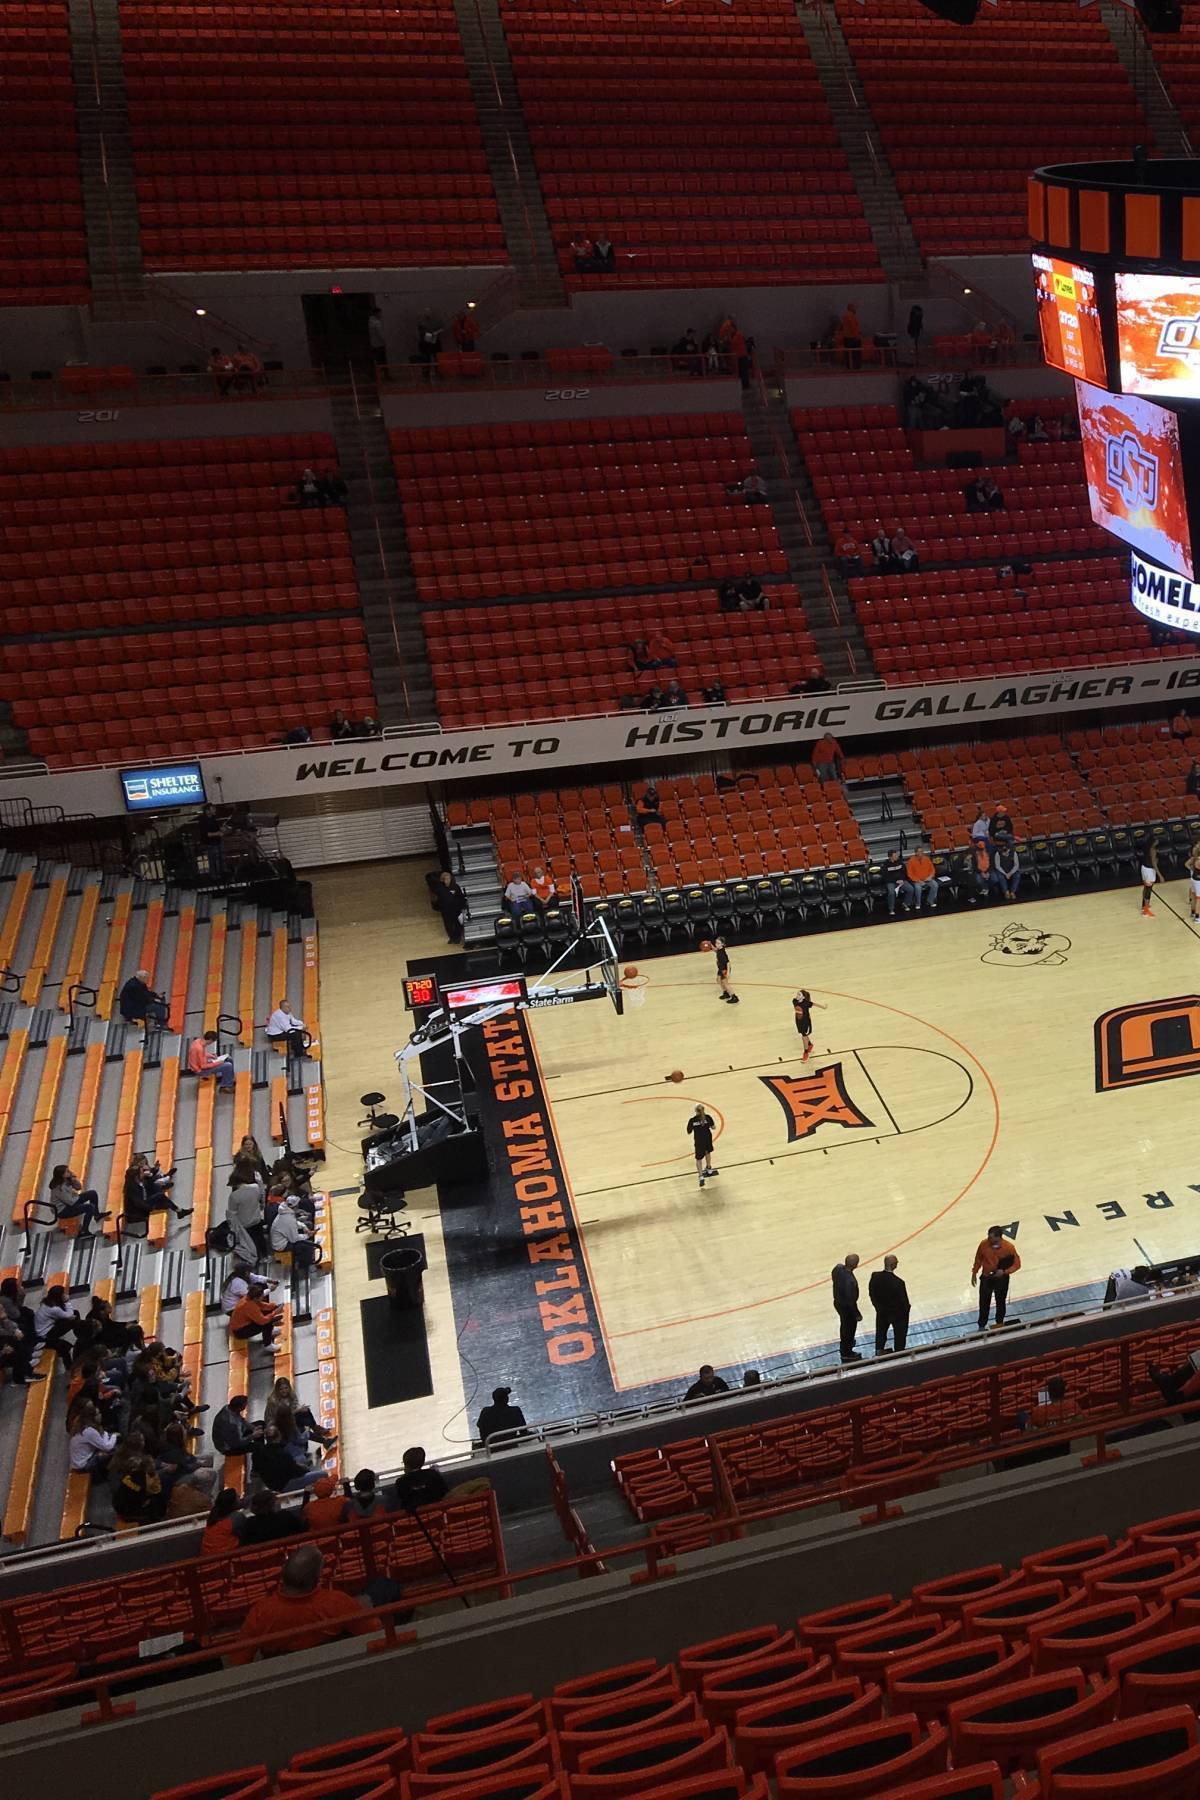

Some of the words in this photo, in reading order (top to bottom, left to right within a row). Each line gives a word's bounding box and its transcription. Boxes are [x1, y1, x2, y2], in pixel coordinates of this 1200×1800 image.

[544, 388, 590, 401] 202
[77, 409, 120, 423] 201
[1106, 431, 1158, 511] OSU
[295, 744, 496, 782] WELCOME
[507, 737, 561, 757] TO
[624, 705, 852, 748] HISTORIC
[149, 774, 199, 789] SHELTER
[151, 784, 201, 797] INSURANCE
[405, 979, 433, 993] 37:20
[480, 1006, 535, 1103] STAT
[502, 1112, 596, 1366] OKLAHOMA
